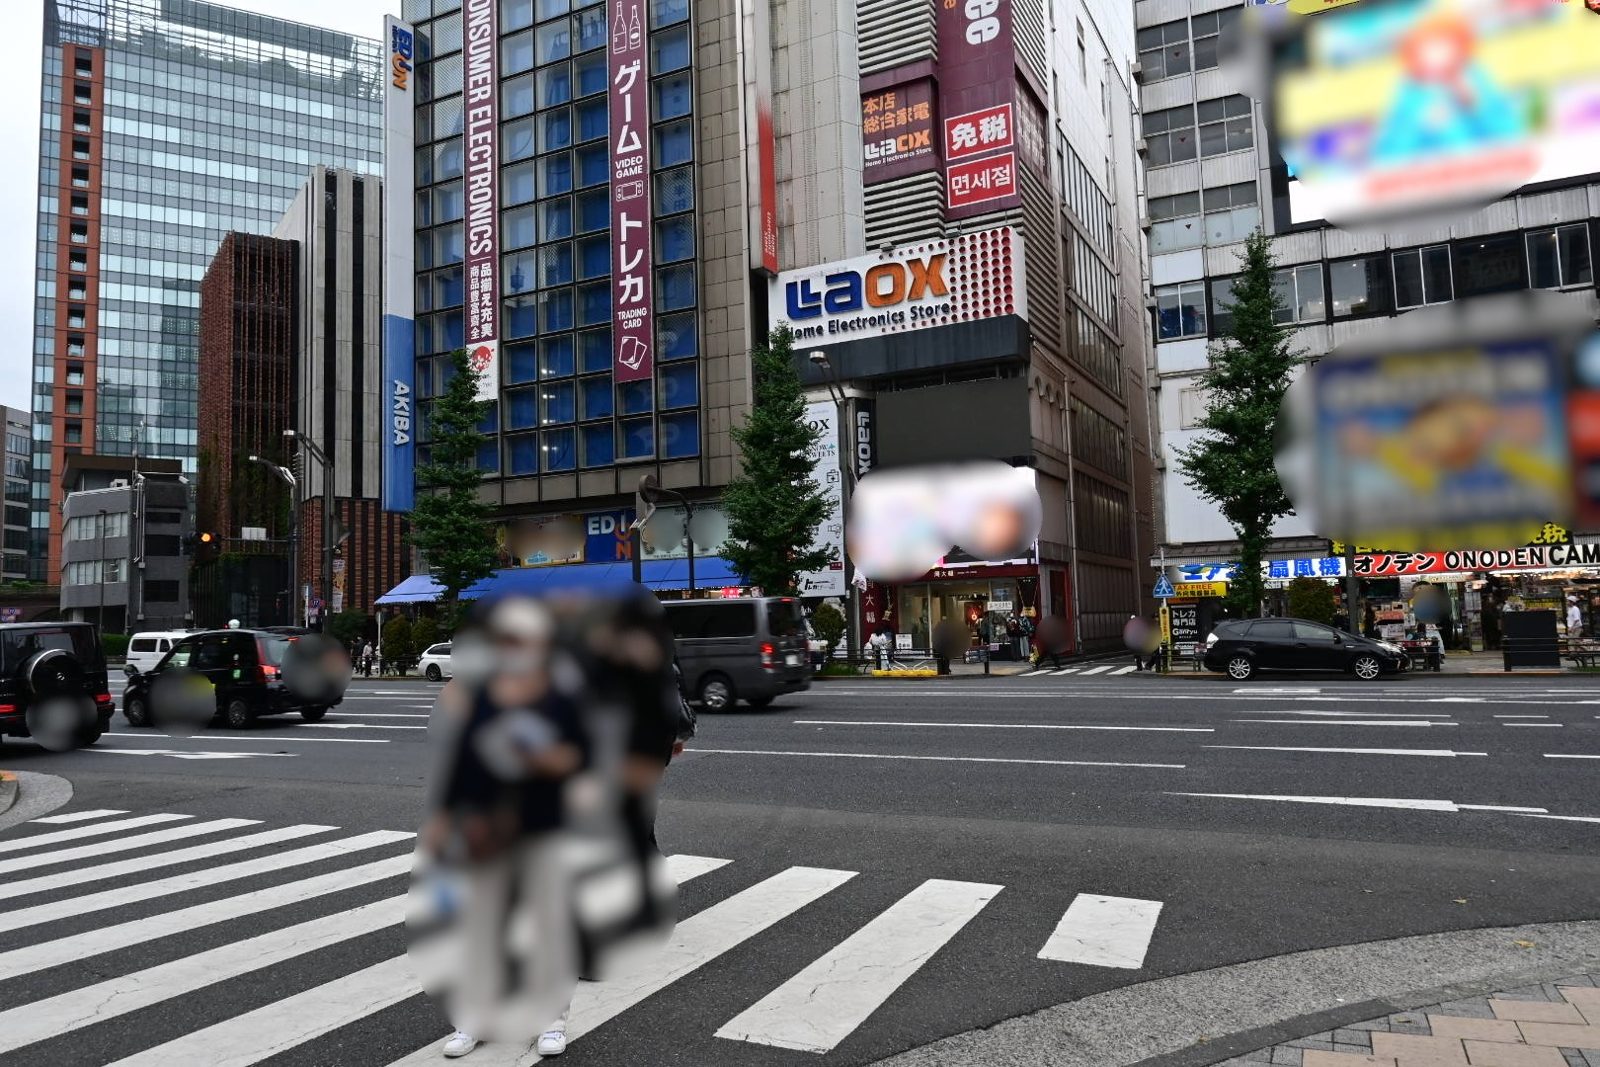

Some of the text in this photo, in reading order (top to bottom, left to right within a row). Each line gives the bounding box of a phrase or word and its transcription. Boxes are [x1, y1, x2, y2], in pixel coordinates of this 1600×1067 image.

[615, 59, 642, 154] ゲーム
[863, 92, 896, 114] 本店
[863, 101, 930, 134] 総合家電
[951, 113, 1008, 151] 免税
[615, 156, 643, 169] VIDEO
[616, 165, 643, 179] GAME
[469, 104, 493, 256] ELECTRONICS
[952, 164, 1011, 196] 면세점
[619, 212, 644, 304] トレカ
[481, 263, 493, 338] 品揃え充実
[618, 307, 648, 320] TRADING
[623, 318, 642, 330] CARD
[828, 310, 905, 334] Electronics
[910, 302, 950, 320] Store
[394, 380, 410, 445] AKIBA
[1268, 556, 1342, 578] 扇風機
[1354, 553, 1436, 573] オノデン
[1445, 544, 1600, 570] ONODEN CAM
[1172, 609, 1196, 618] トレカ
[1172, 618, 1196, 626] 専門店
